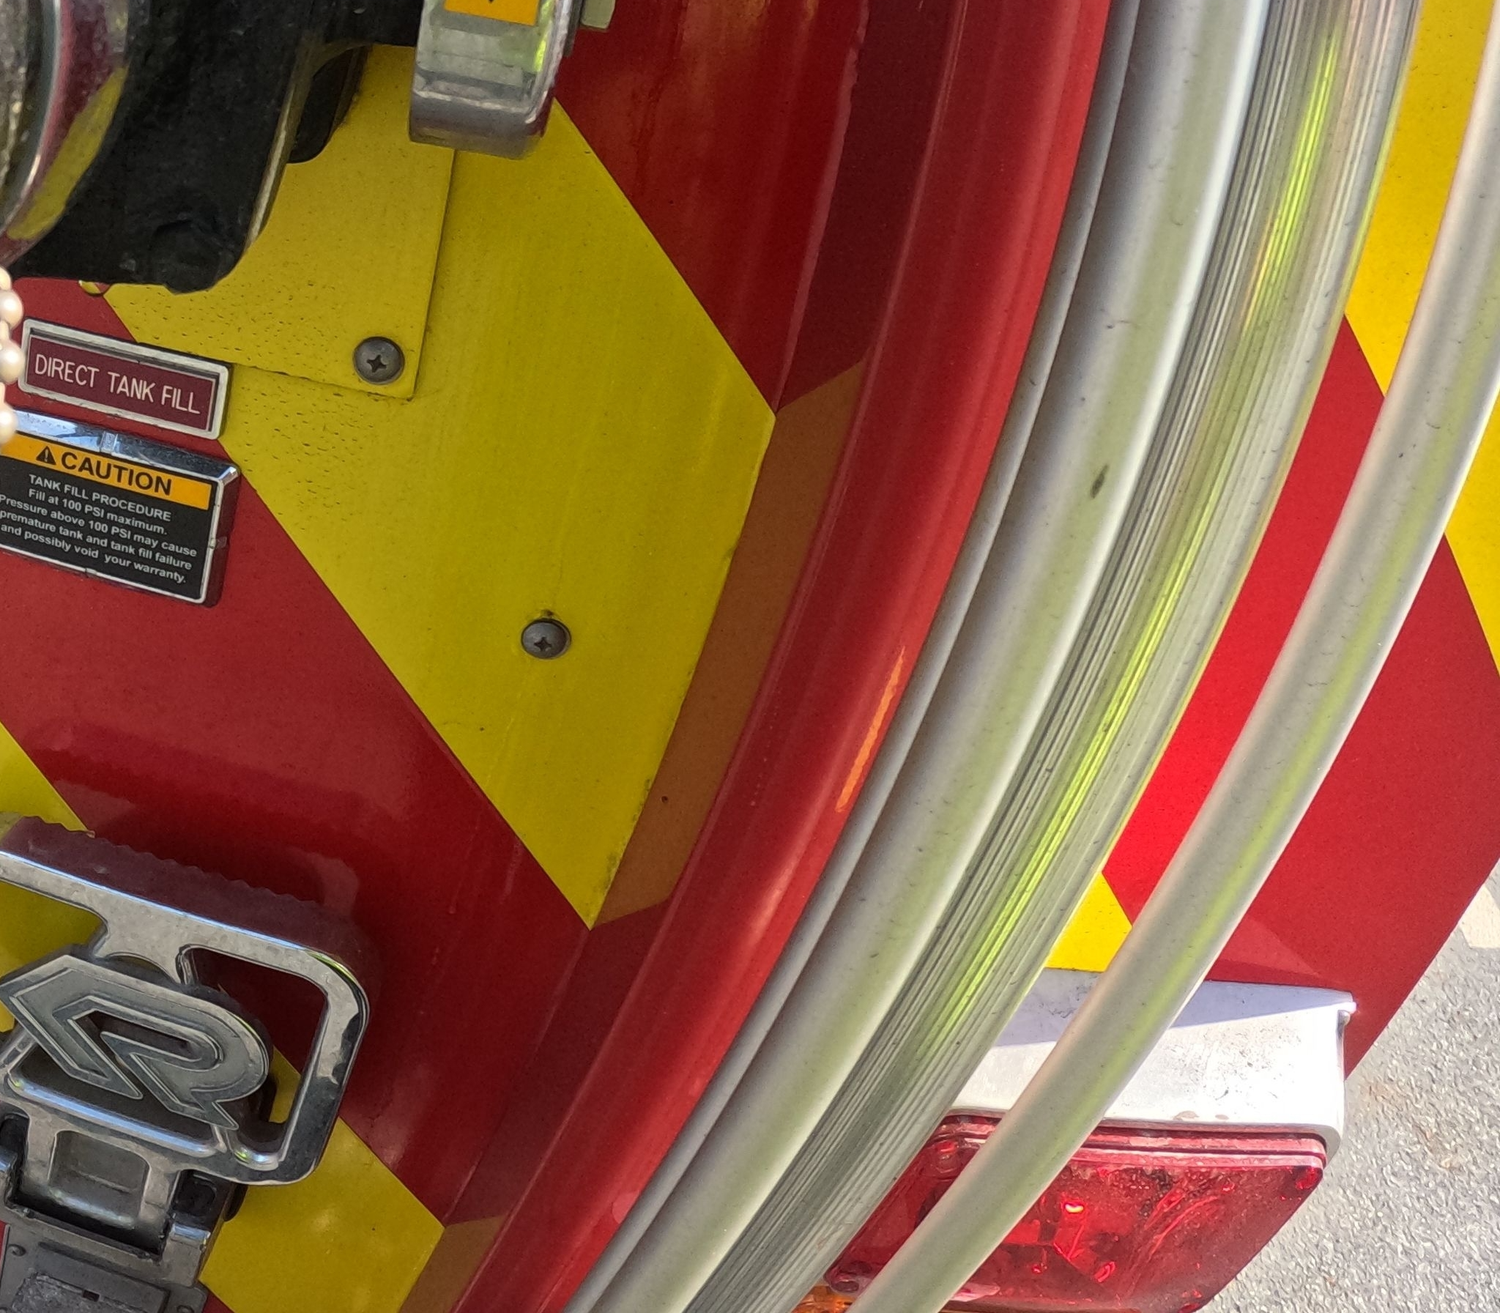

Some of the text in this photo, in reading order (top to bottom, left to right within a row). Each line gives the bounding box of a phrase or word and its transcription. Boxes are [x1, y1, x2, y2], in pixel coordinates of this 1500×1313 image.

[34, 353, 201, 415] DIRECT TANK FILL
[28, 473, 172, 522] TANK FILL PROCEDURE
[61, 451, 172, 496] CAUTION
[28, 488, 168, 536] Fill at 100 PSI maximum.
[50, 509, 85, 527] above
[88, 519, 109, 534] 100
[111, 526, 131, 540] PSI
[133, 533, 159, 549] may
[161, 541, 197, 558] cause
[0, 509, 192, 570] premature tank and tank fill failure
[0, 522, 187, 584] and possibly void your warranty.
